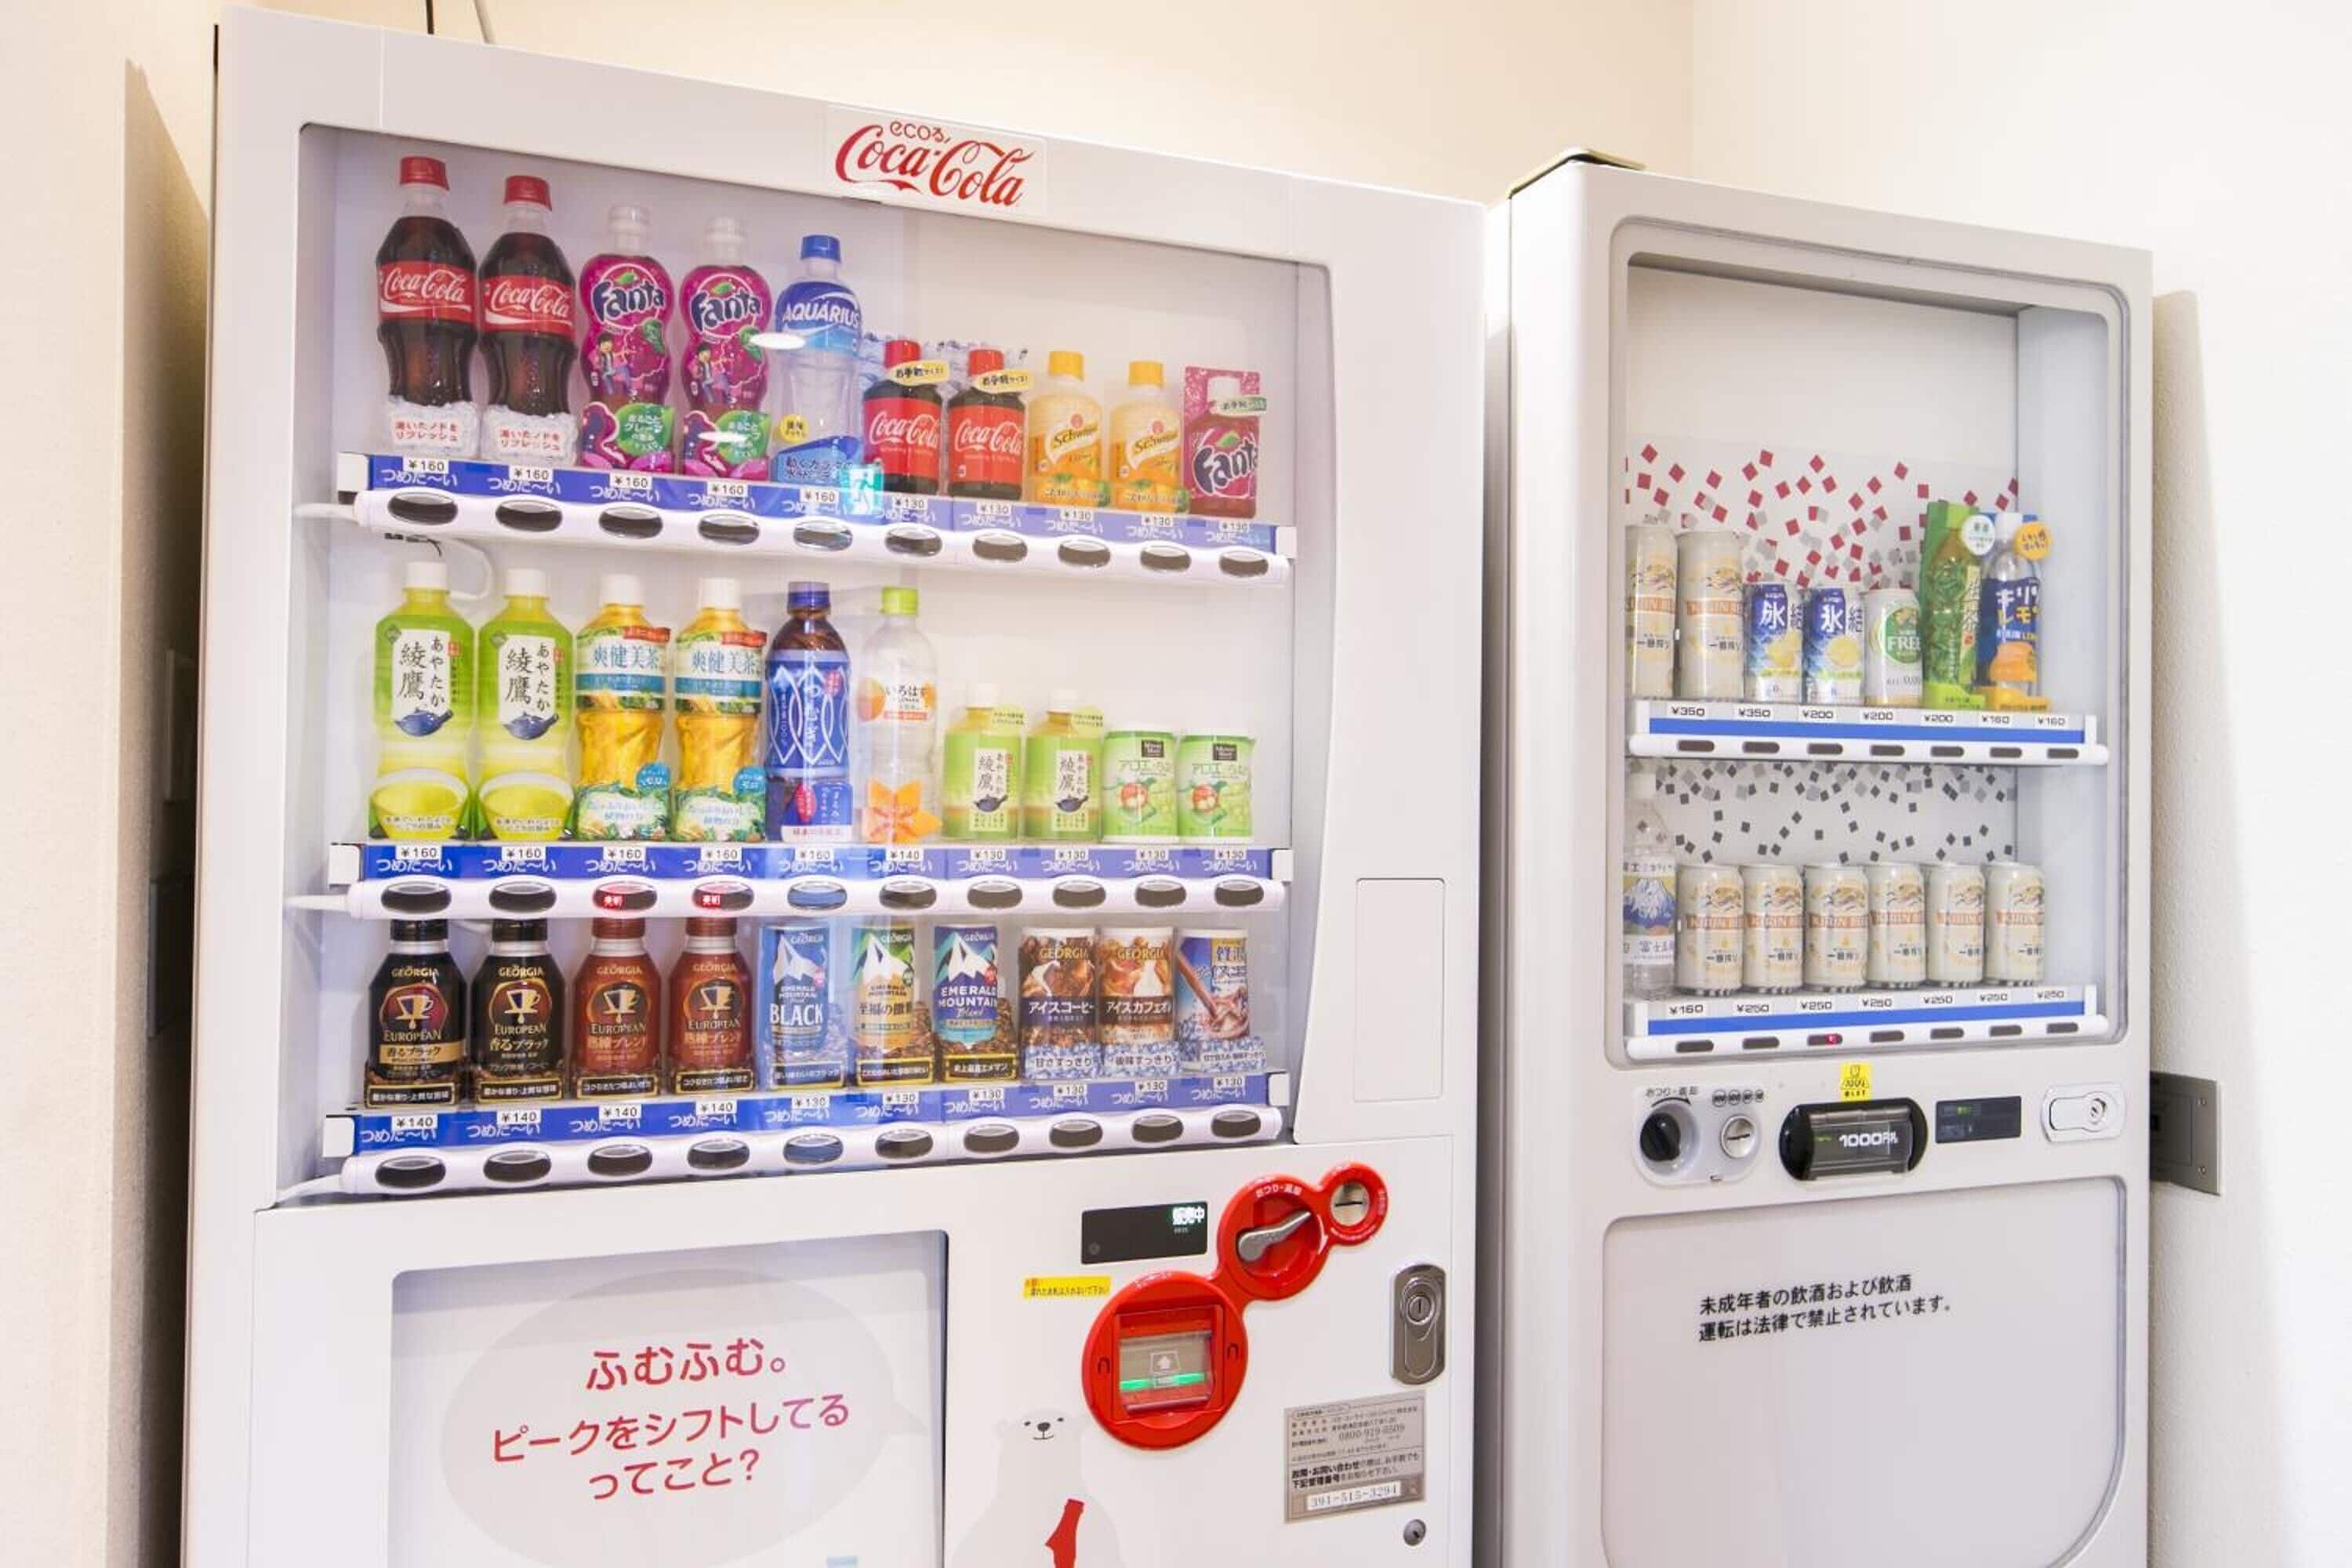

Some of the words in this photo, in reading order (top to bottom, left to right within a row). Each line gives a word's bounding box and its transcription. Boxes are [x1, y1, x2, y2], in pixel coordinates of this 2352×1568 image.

[836, 125, 1036, 207] Coca-Cola
[384, 267, 465, 303] Coca-Cola
[491, 281, 570, 318] Coca-Cola
[593, 281, 665, 322] Fanta
[691, 290, 760, 332] Fanta
[782, 303, 859, 328] AQUARIUS
[397, 641, 427, 701] 綾鷹
[431, 636, 445, 707] あやたか
[505, 647, 533, 706] 綾鷹
[536, 642, 551, 713] あやたか
[495, 1023, 546, 1036] EUROPEAN
[591, 1022, 648, 1035] EUROPEAN
[688, 1018, 741, 1031] EUROPEAN
[769, 1003, 822, 1027] BLACK
[1669, 1004, 1704, 1015] ¥160
[383, 1029, 442, 1042] EUROPEAN
[1700, 1273, 1911, 1316] 未成年者の飲酒および飲酒
[1698, 1294, 1951, 1342] 運転は法律で禁止されています。
[586, 1338, 785, 1391] ふむふむ。
[490, 1393, 850, 1462] ピークをシフトしてる
